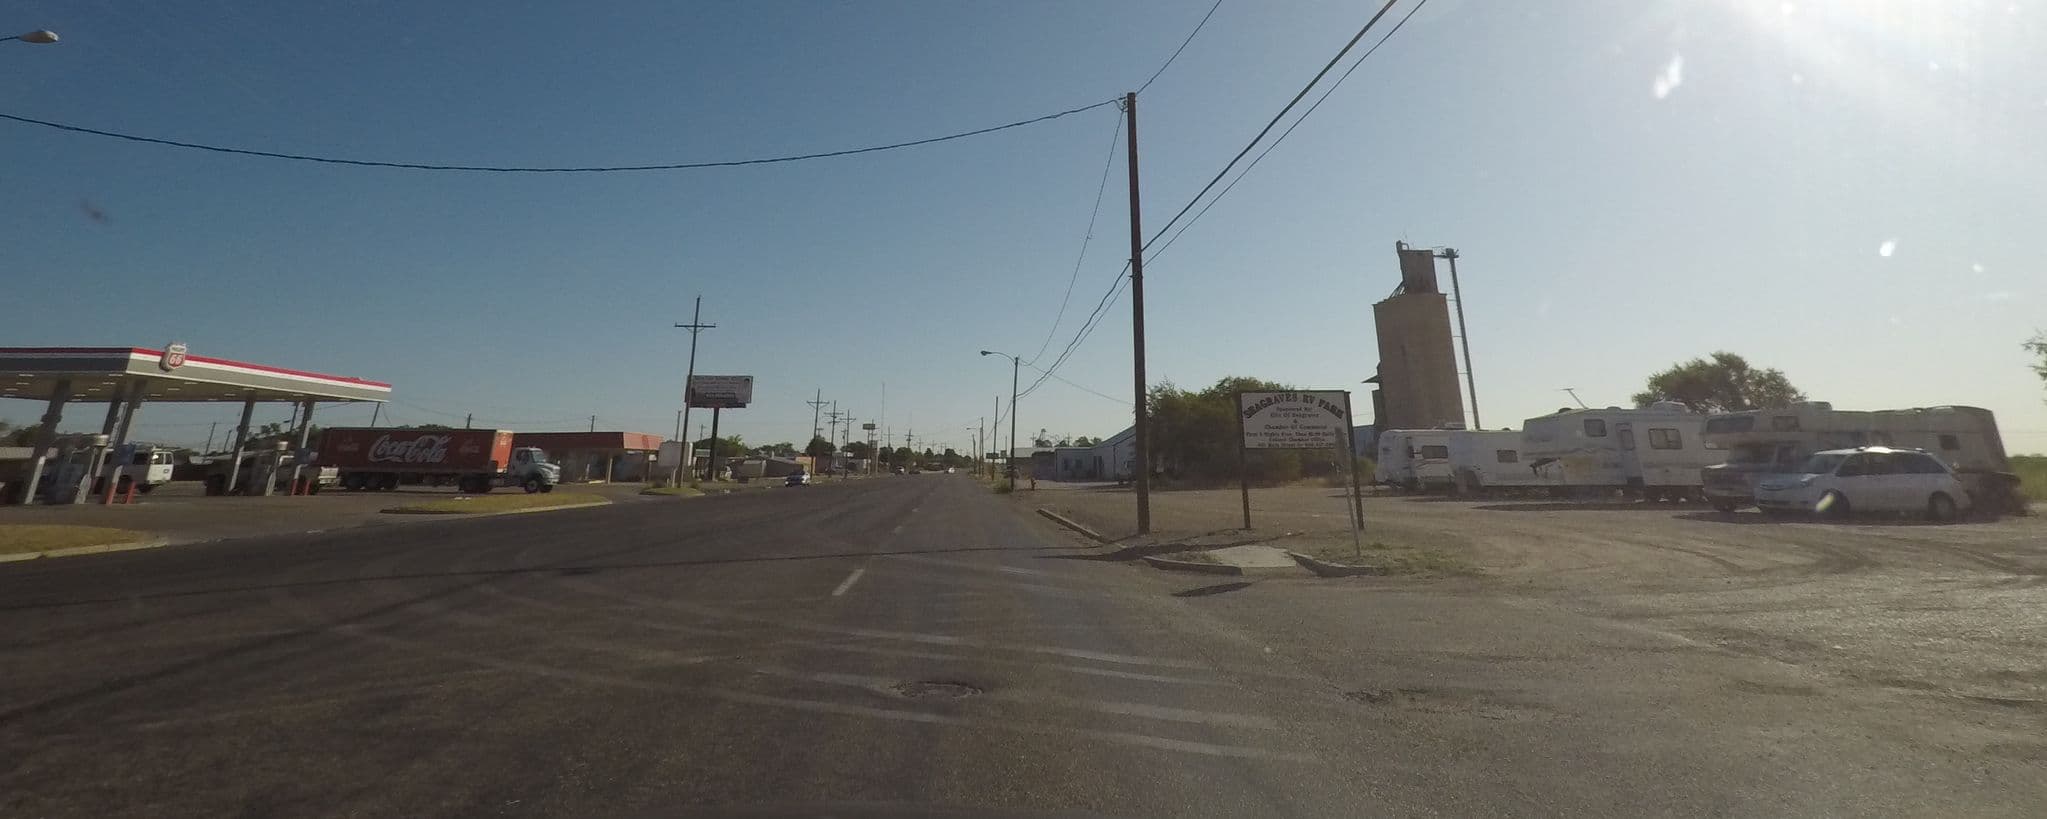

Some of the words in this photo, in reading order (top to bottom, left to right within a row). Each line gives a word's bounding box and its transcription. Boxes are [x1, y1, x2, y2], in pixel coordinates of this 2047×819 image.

[169, 352, 180, 361] 66
[1243, 393, 1298, 419] SEAGRAVES
[1303, 394, 1316, 405] RV
[1318, 398, 1345, 419] PARK
